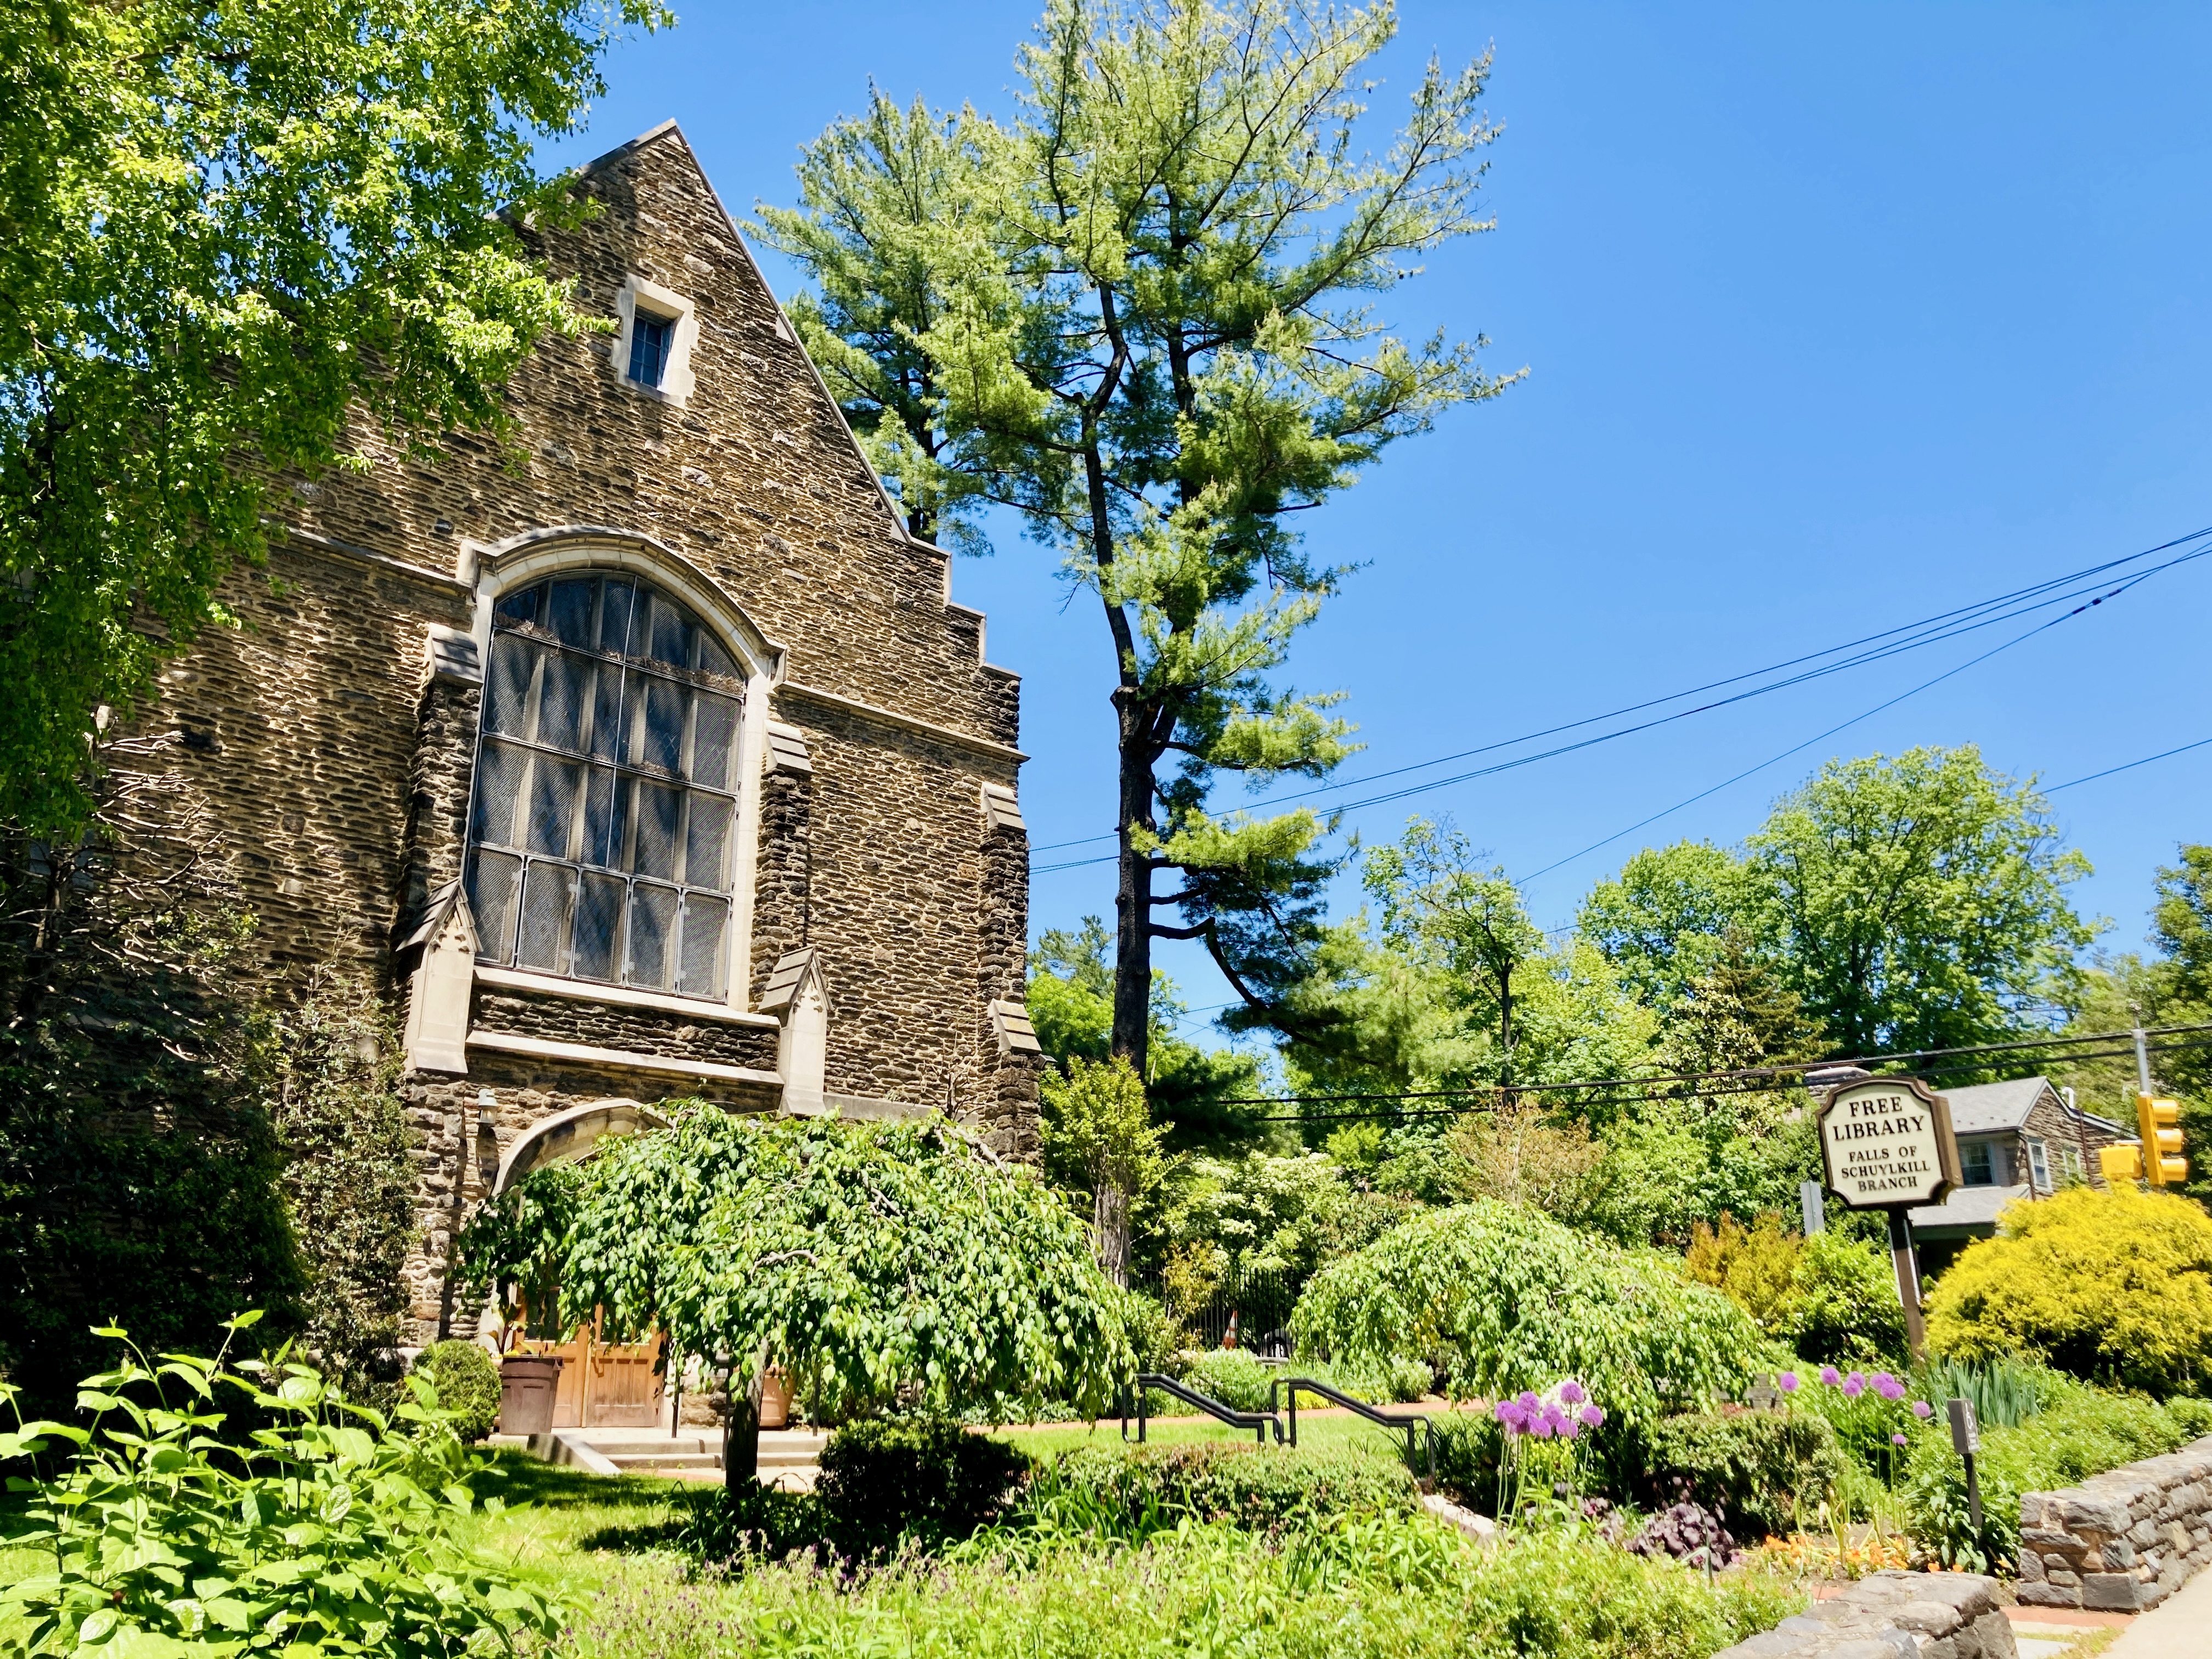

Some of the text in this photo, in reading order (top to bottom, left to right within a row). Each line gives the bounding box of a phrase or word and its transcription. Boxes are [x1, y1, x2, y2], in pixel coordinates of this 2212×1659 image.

[1849, 1097, 1903, 1117] FREE
[1833, 1115, 1925, 1141] LIBRARY
[1849, 1146, 1917, 1162] FALLS OF
[1841, 1160, 1931, 1178] SCHUYLKILL
[1858, 1176, 1918, 1192] BRANCH
